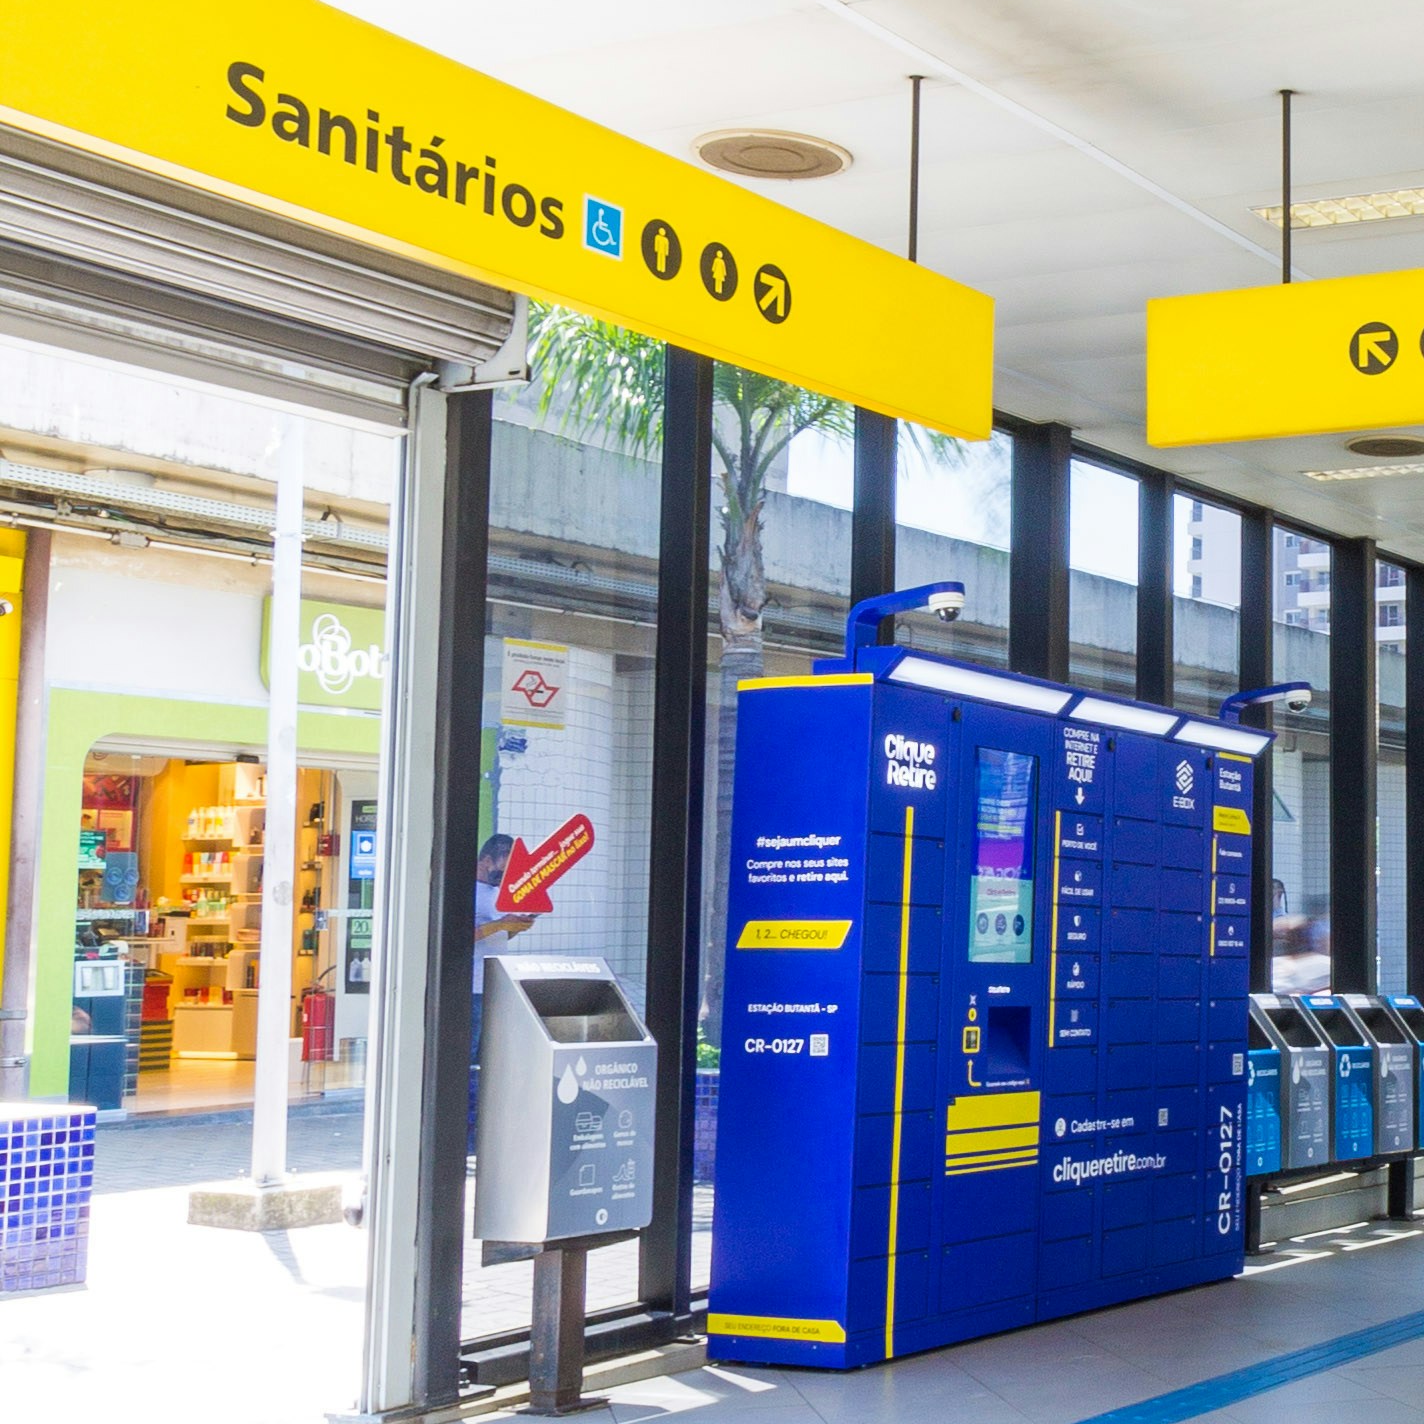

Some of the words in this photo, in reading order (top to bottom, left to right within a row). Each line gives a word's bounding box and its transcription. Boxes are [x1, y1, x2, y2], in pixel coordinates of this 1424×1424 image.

[224, 60, 565, 241] Sanitários
[884, 733, 936, 767] Clique
[1064, 739, 1093, 753] INTERNET
[1066, 751, 1096, 769] RETIRE
[886, 760, 937, 791] Retire
[756, 834, 841, 850] #sejaumcliquer
[746, 859, 783, 871] Compre
[784, 860, 802, 869] nos
[803, 859, 825, 868] seus
[827, 857, 849, 867] sites
[508, 871, 532, 893] Quando
[512, 882, 534, 904] GOMA
[530, 873, 543, 888] DE
[539, 850, 568, 880] MASCAR
[748, 873, 787, 883] favoritos
[788, 874, 795, 882] e
[796, 871, 824, 882] retire
[779, 929, 829, 940] CHEGOU!
[747, 1003, 784, 1015] ESTAÇÃO
[784, 1003, 821, 1014] BUTANTÃ
[826, 1004, 839, 1014] SP
[744, 1038, 805, 1054] CR-0127
[594, 1061, 639, 1076] ORGÂNICO
[582, 1078, 602, 1091] NÃO
[603, 1076, 649, 1090] RECICLÁVEL
[1070, 1118, 1120, 1134] Cadastre-se
[1121, 1116, 1135, 1127] em
[1053, 1149, 1167, 1186] cliqueretire.com.br
[1218, 1105, 1233, 1235] CR-0127
[737, 1322, 772, 1333] ENDEREÇO
[772, 1325, 790, 1333] FORA
[791, 1326, 801, 1334] DE
